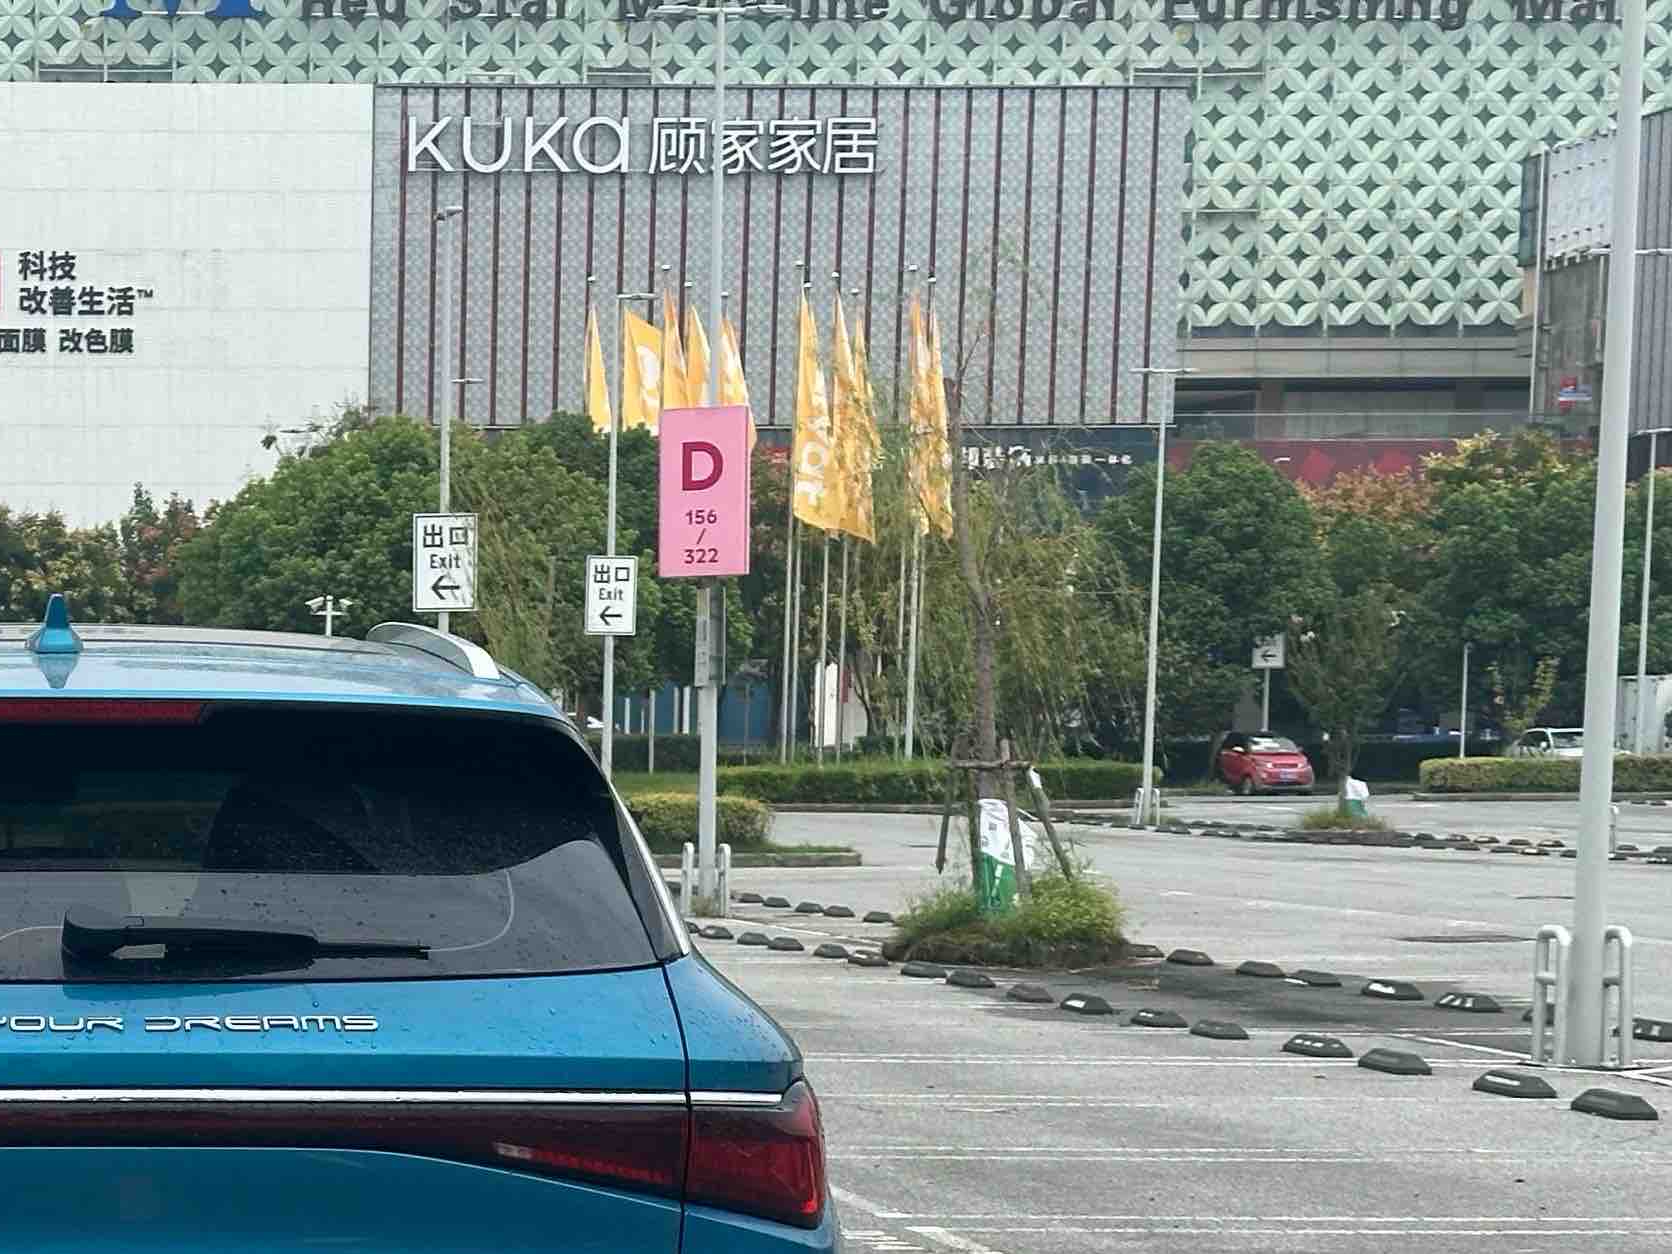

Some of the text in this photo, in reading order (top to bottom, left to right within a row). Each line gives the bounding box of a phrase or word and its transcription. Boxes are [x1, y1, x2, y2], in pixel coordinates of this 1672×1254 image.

[648, 116, 879, 175] 顾家家居
[18, 250, 77, 281] 科技
[58, 327, 135, 354] 改色膜
[682, 441, 724, 491] D
[685, 509, 718, 525] 156
[423, 523, 469, 549] 出口
[429, 553, 461, 570] Exit
[684, 548, 719, 564] 322
[593, 563, 630, 584] 出口
[598, 587, 624, 601] Exit
[144, 1014, 380, 1033] DREAMS
